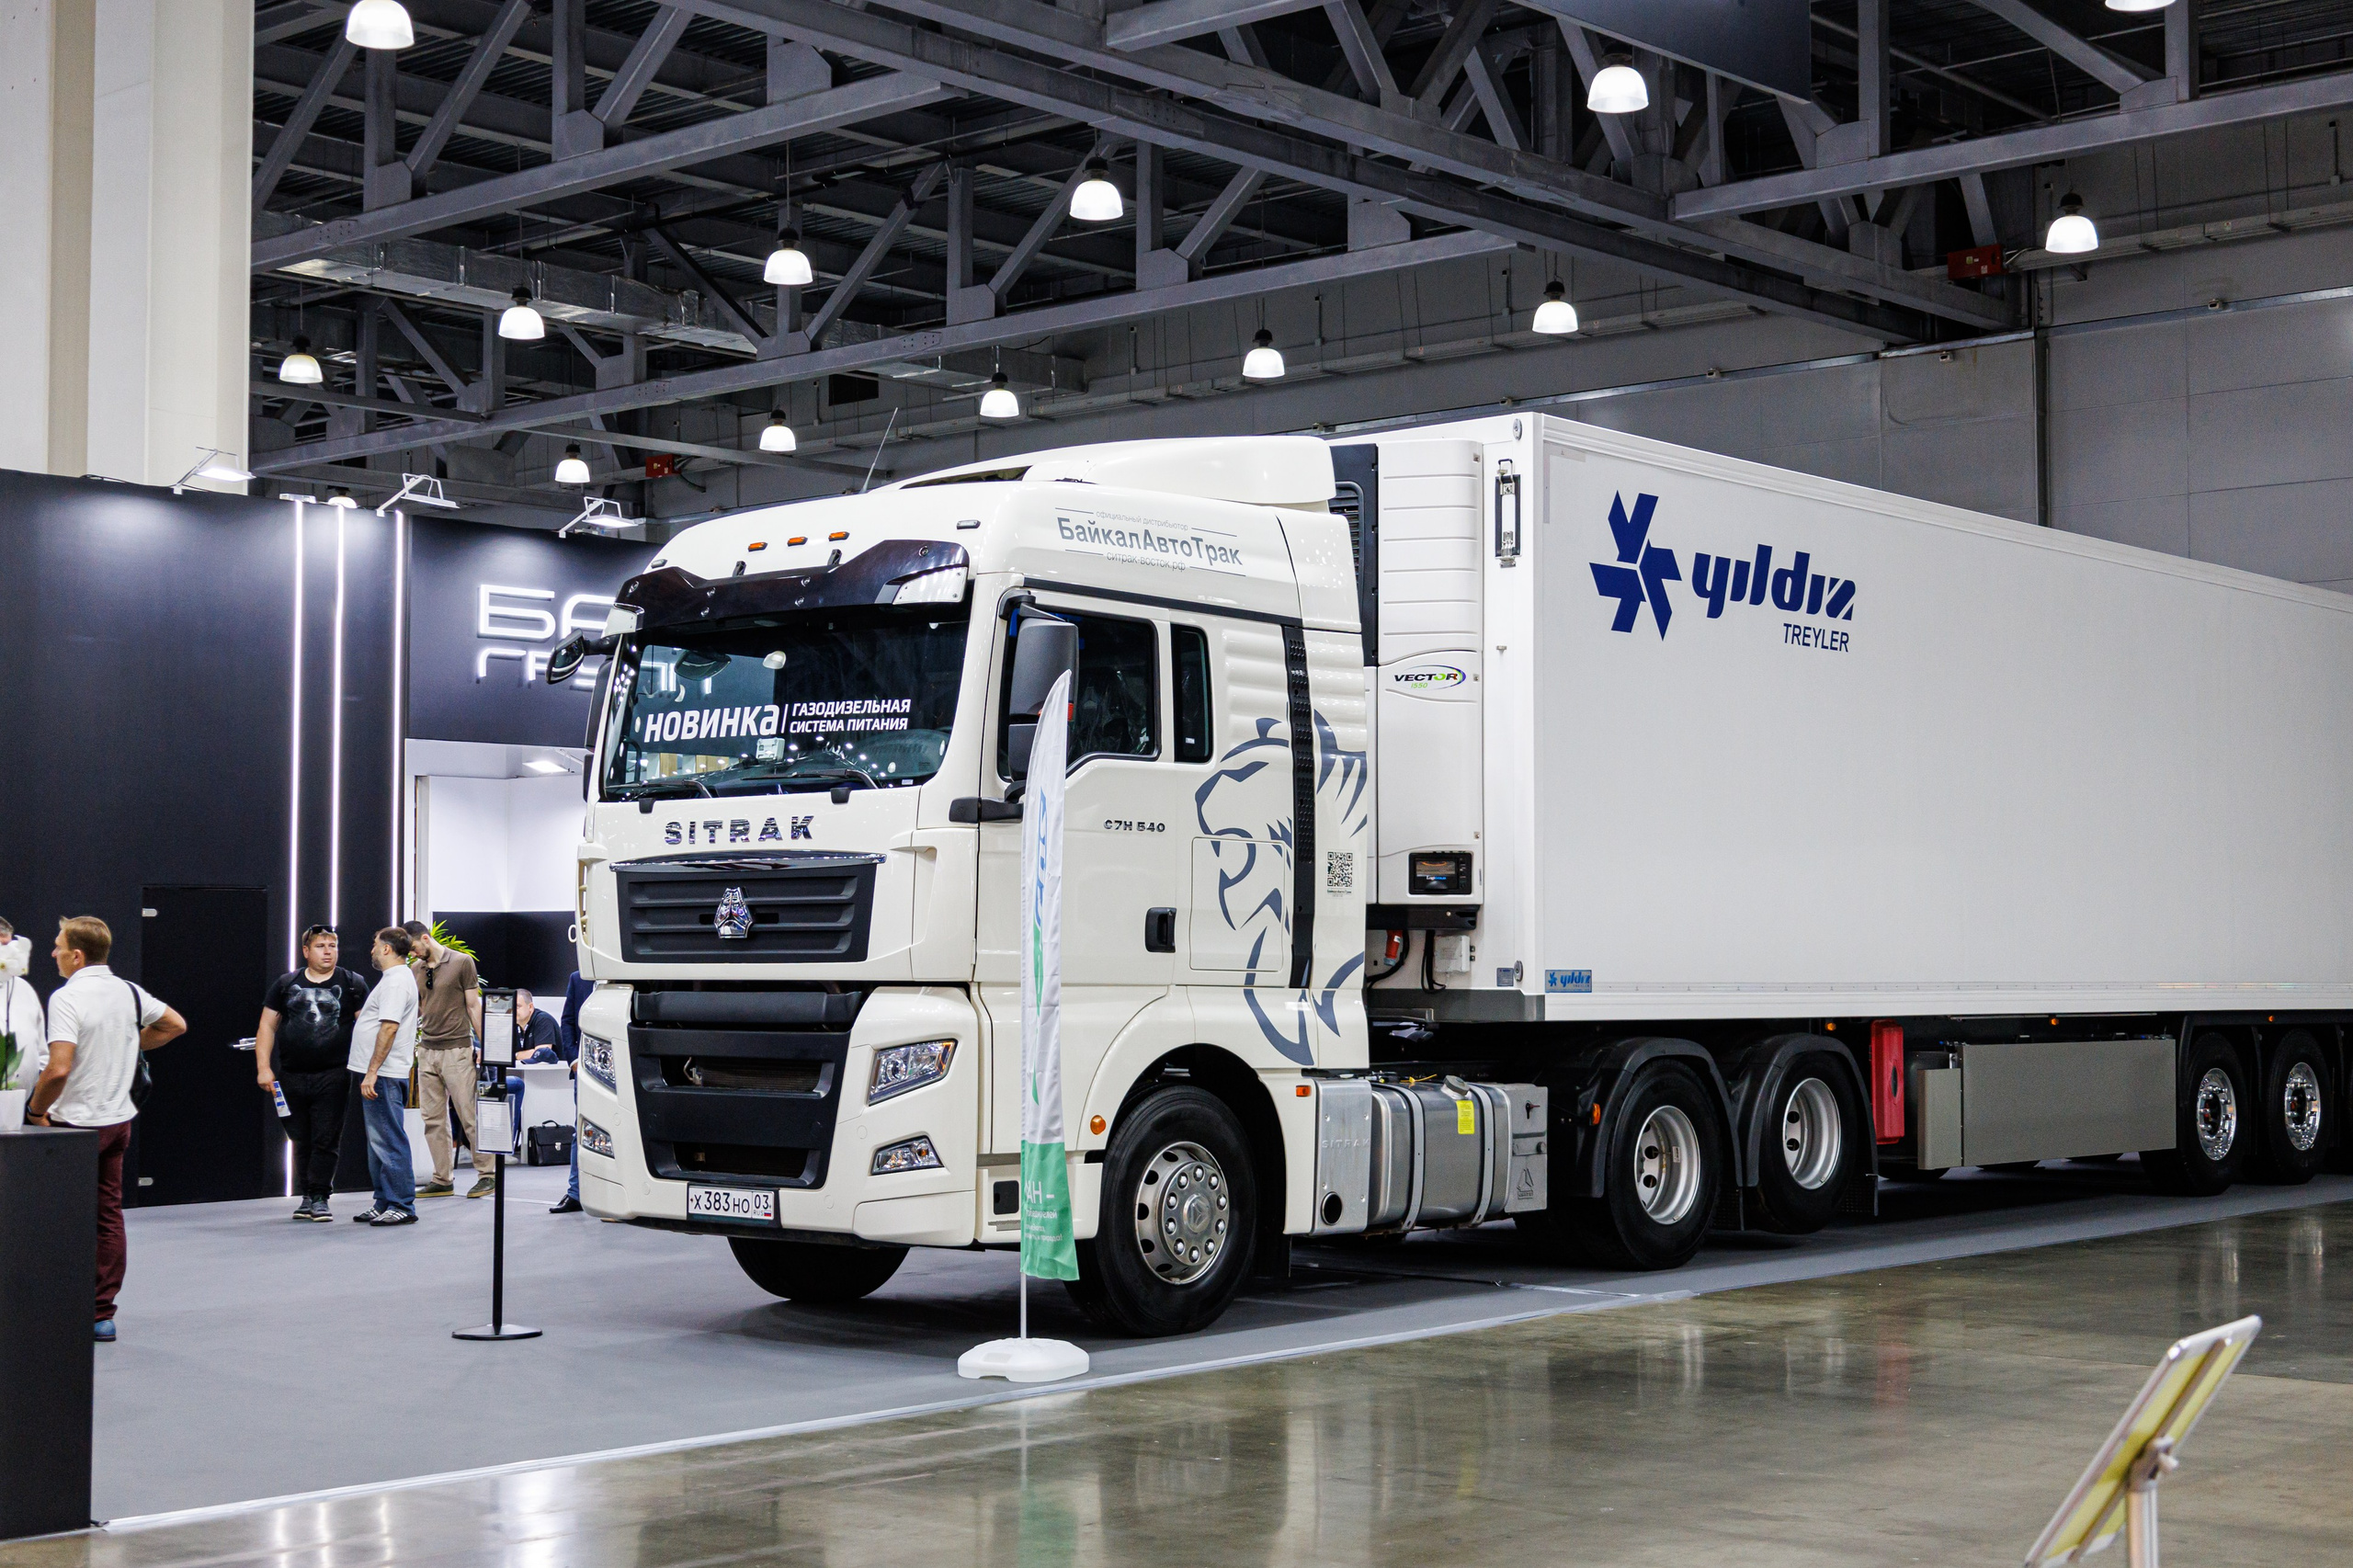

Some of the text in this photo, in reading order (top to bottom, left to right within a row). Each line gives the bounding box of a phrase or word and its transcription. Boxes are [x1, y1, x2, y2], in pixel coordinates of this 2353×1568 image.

[1096, 510, 1188, 531] официальный дистрибьютор
[1057, 517, 1243, 566] БайкалАвтоТрак
[1106, 551, 1186, 572] ситрак-восток.рф
[1783, 622, 1849, 653] TREYLER
[1393, 673, 1459, 682] VECTOR
[791, 699, 911, 717] ГАЗОДИЗЕЛЬНАЯ
[790, 717, 909, 733] СИСТЕМА ПИТАНИЯ
[665, 815, 814, 846] SITRAK
[1104, 819, 1165, 833] C7H 540
